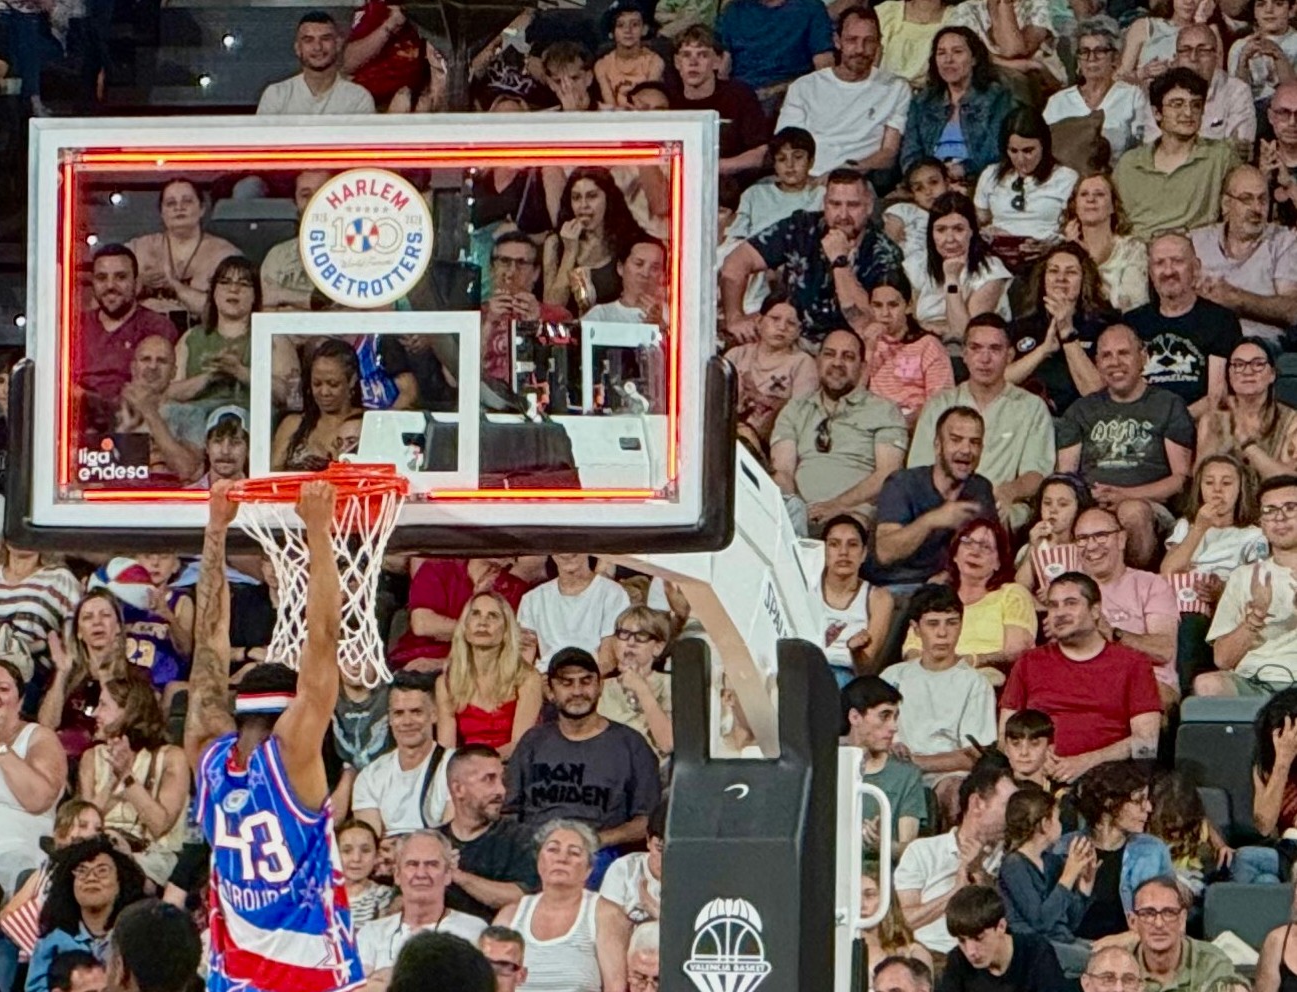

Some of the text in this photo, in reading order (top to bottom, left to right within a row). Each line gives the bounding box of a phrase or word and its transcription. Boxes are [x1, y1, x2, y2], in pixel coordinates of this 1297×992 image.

[325, 178, 411, 213] HARLEM
[308, 229, 424, 299] GLOBETROTTERS
[78, 447, 110, 467] liga
[78, 462, 149, 481] endesa
[214, 803, 296, 884] 43
